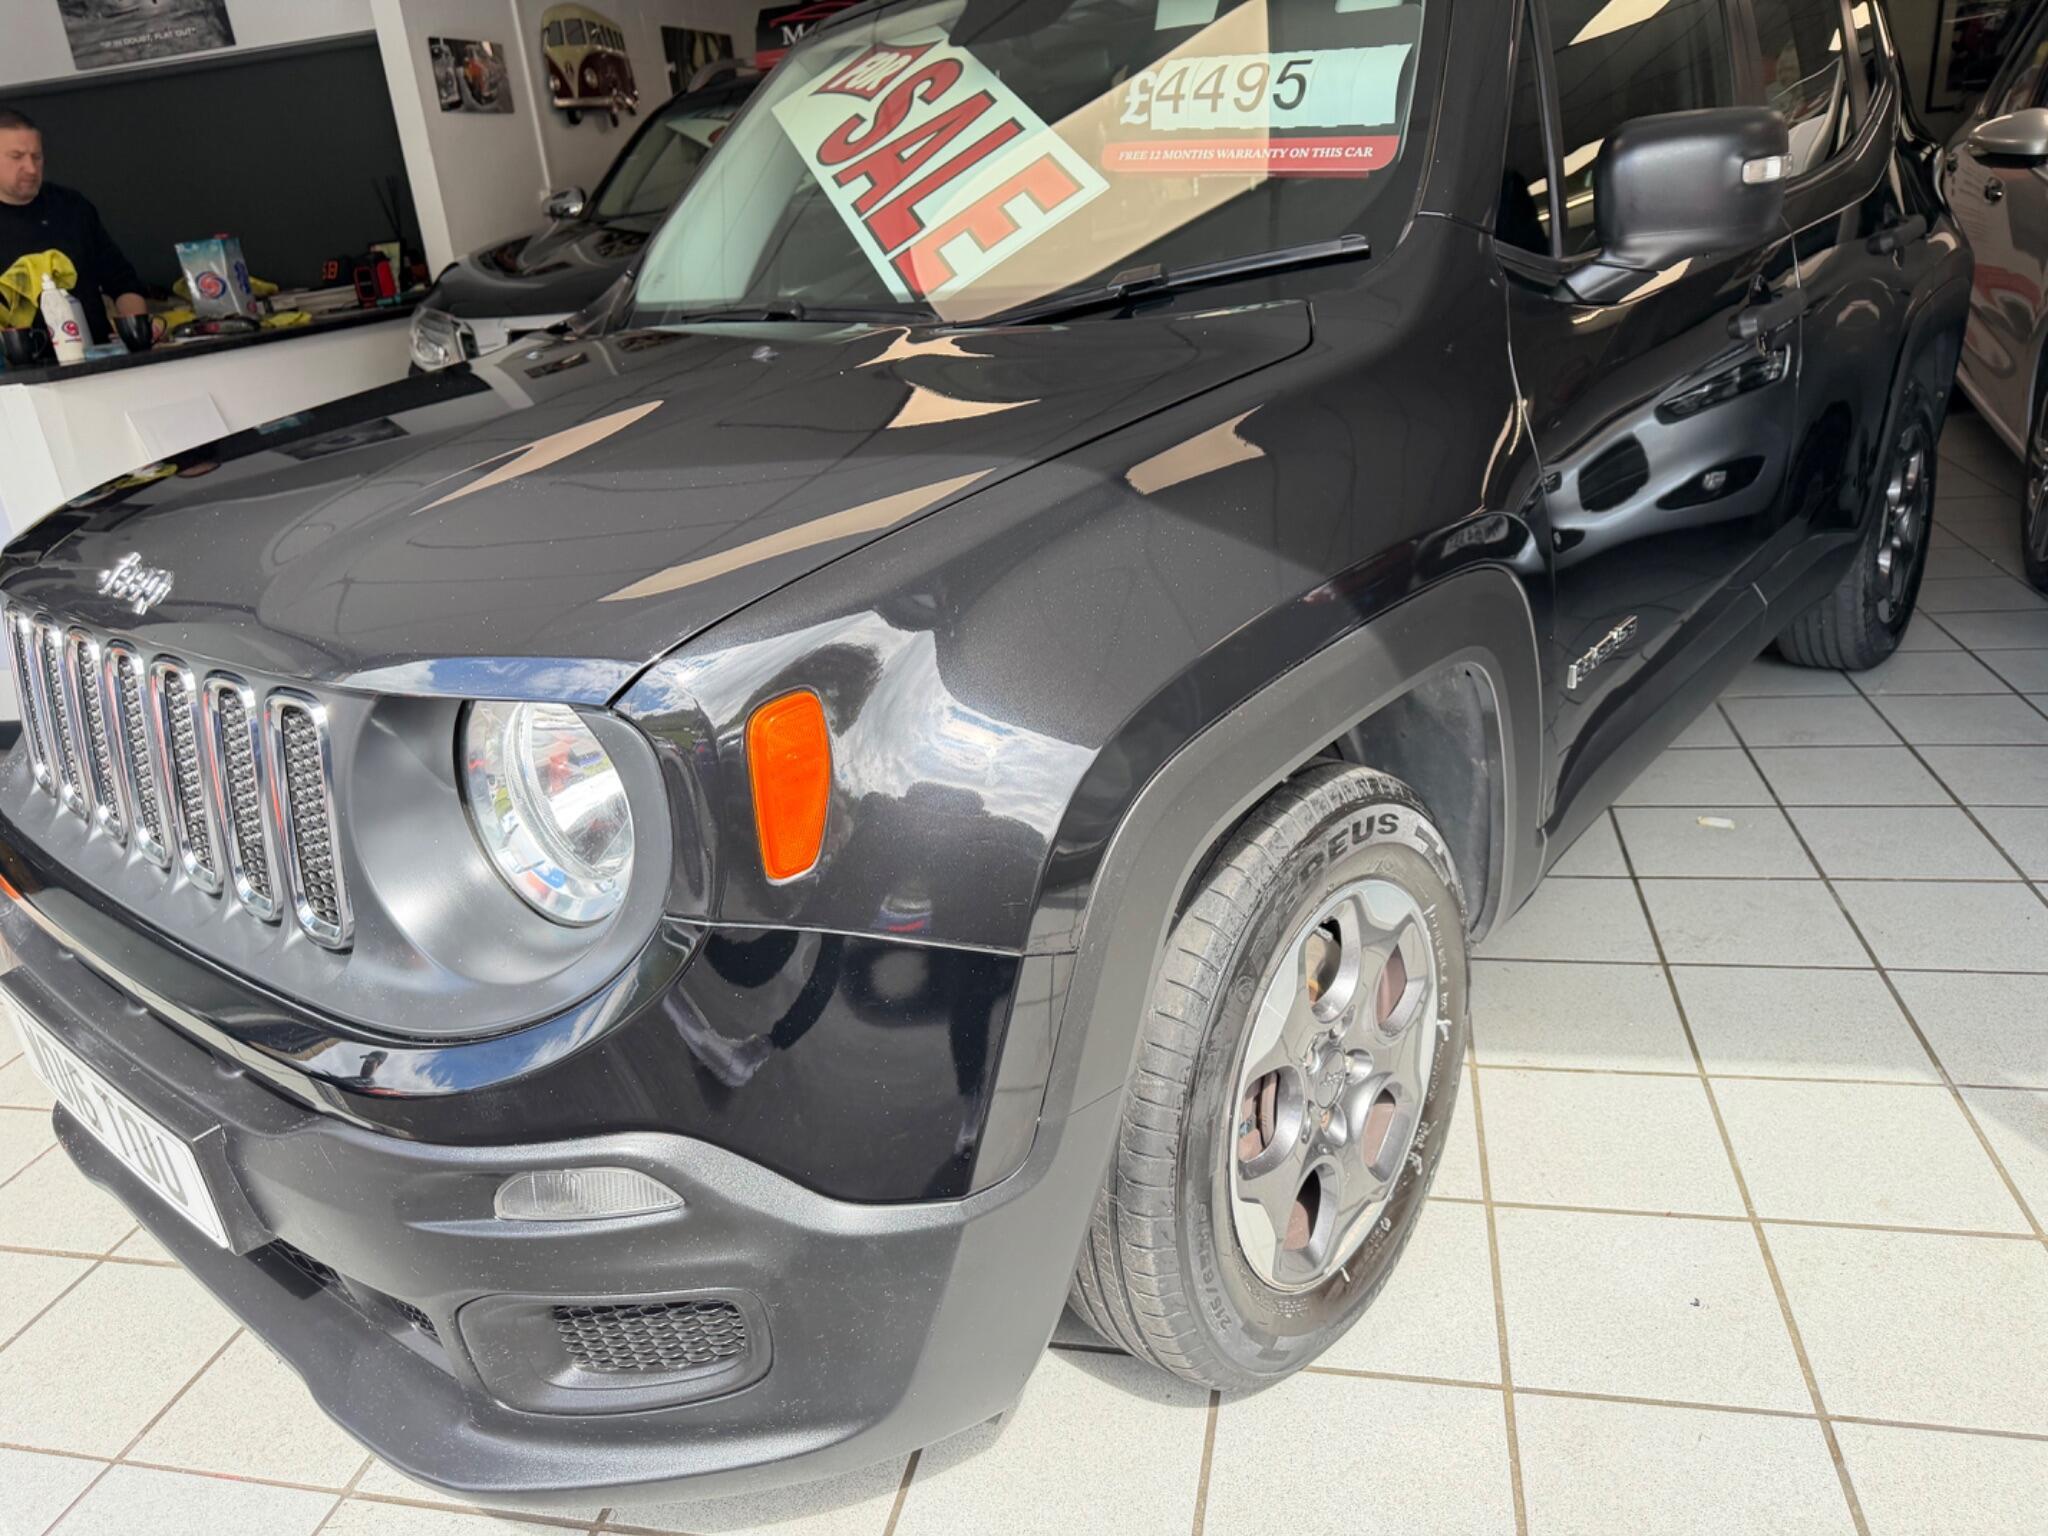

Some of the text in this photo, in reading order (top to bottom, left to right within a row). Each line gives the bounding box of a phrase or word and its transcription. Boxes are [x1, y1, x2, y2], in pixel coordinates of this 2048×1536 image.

[826, 51, 913, 92] FOR
[1119, 58, 1314, 126] £4495
[815, 57, 1086, 301] SALE
[1118, 145, 1374, 162] FREE 12 MONTHS WARRANTY ON THIS CAR
